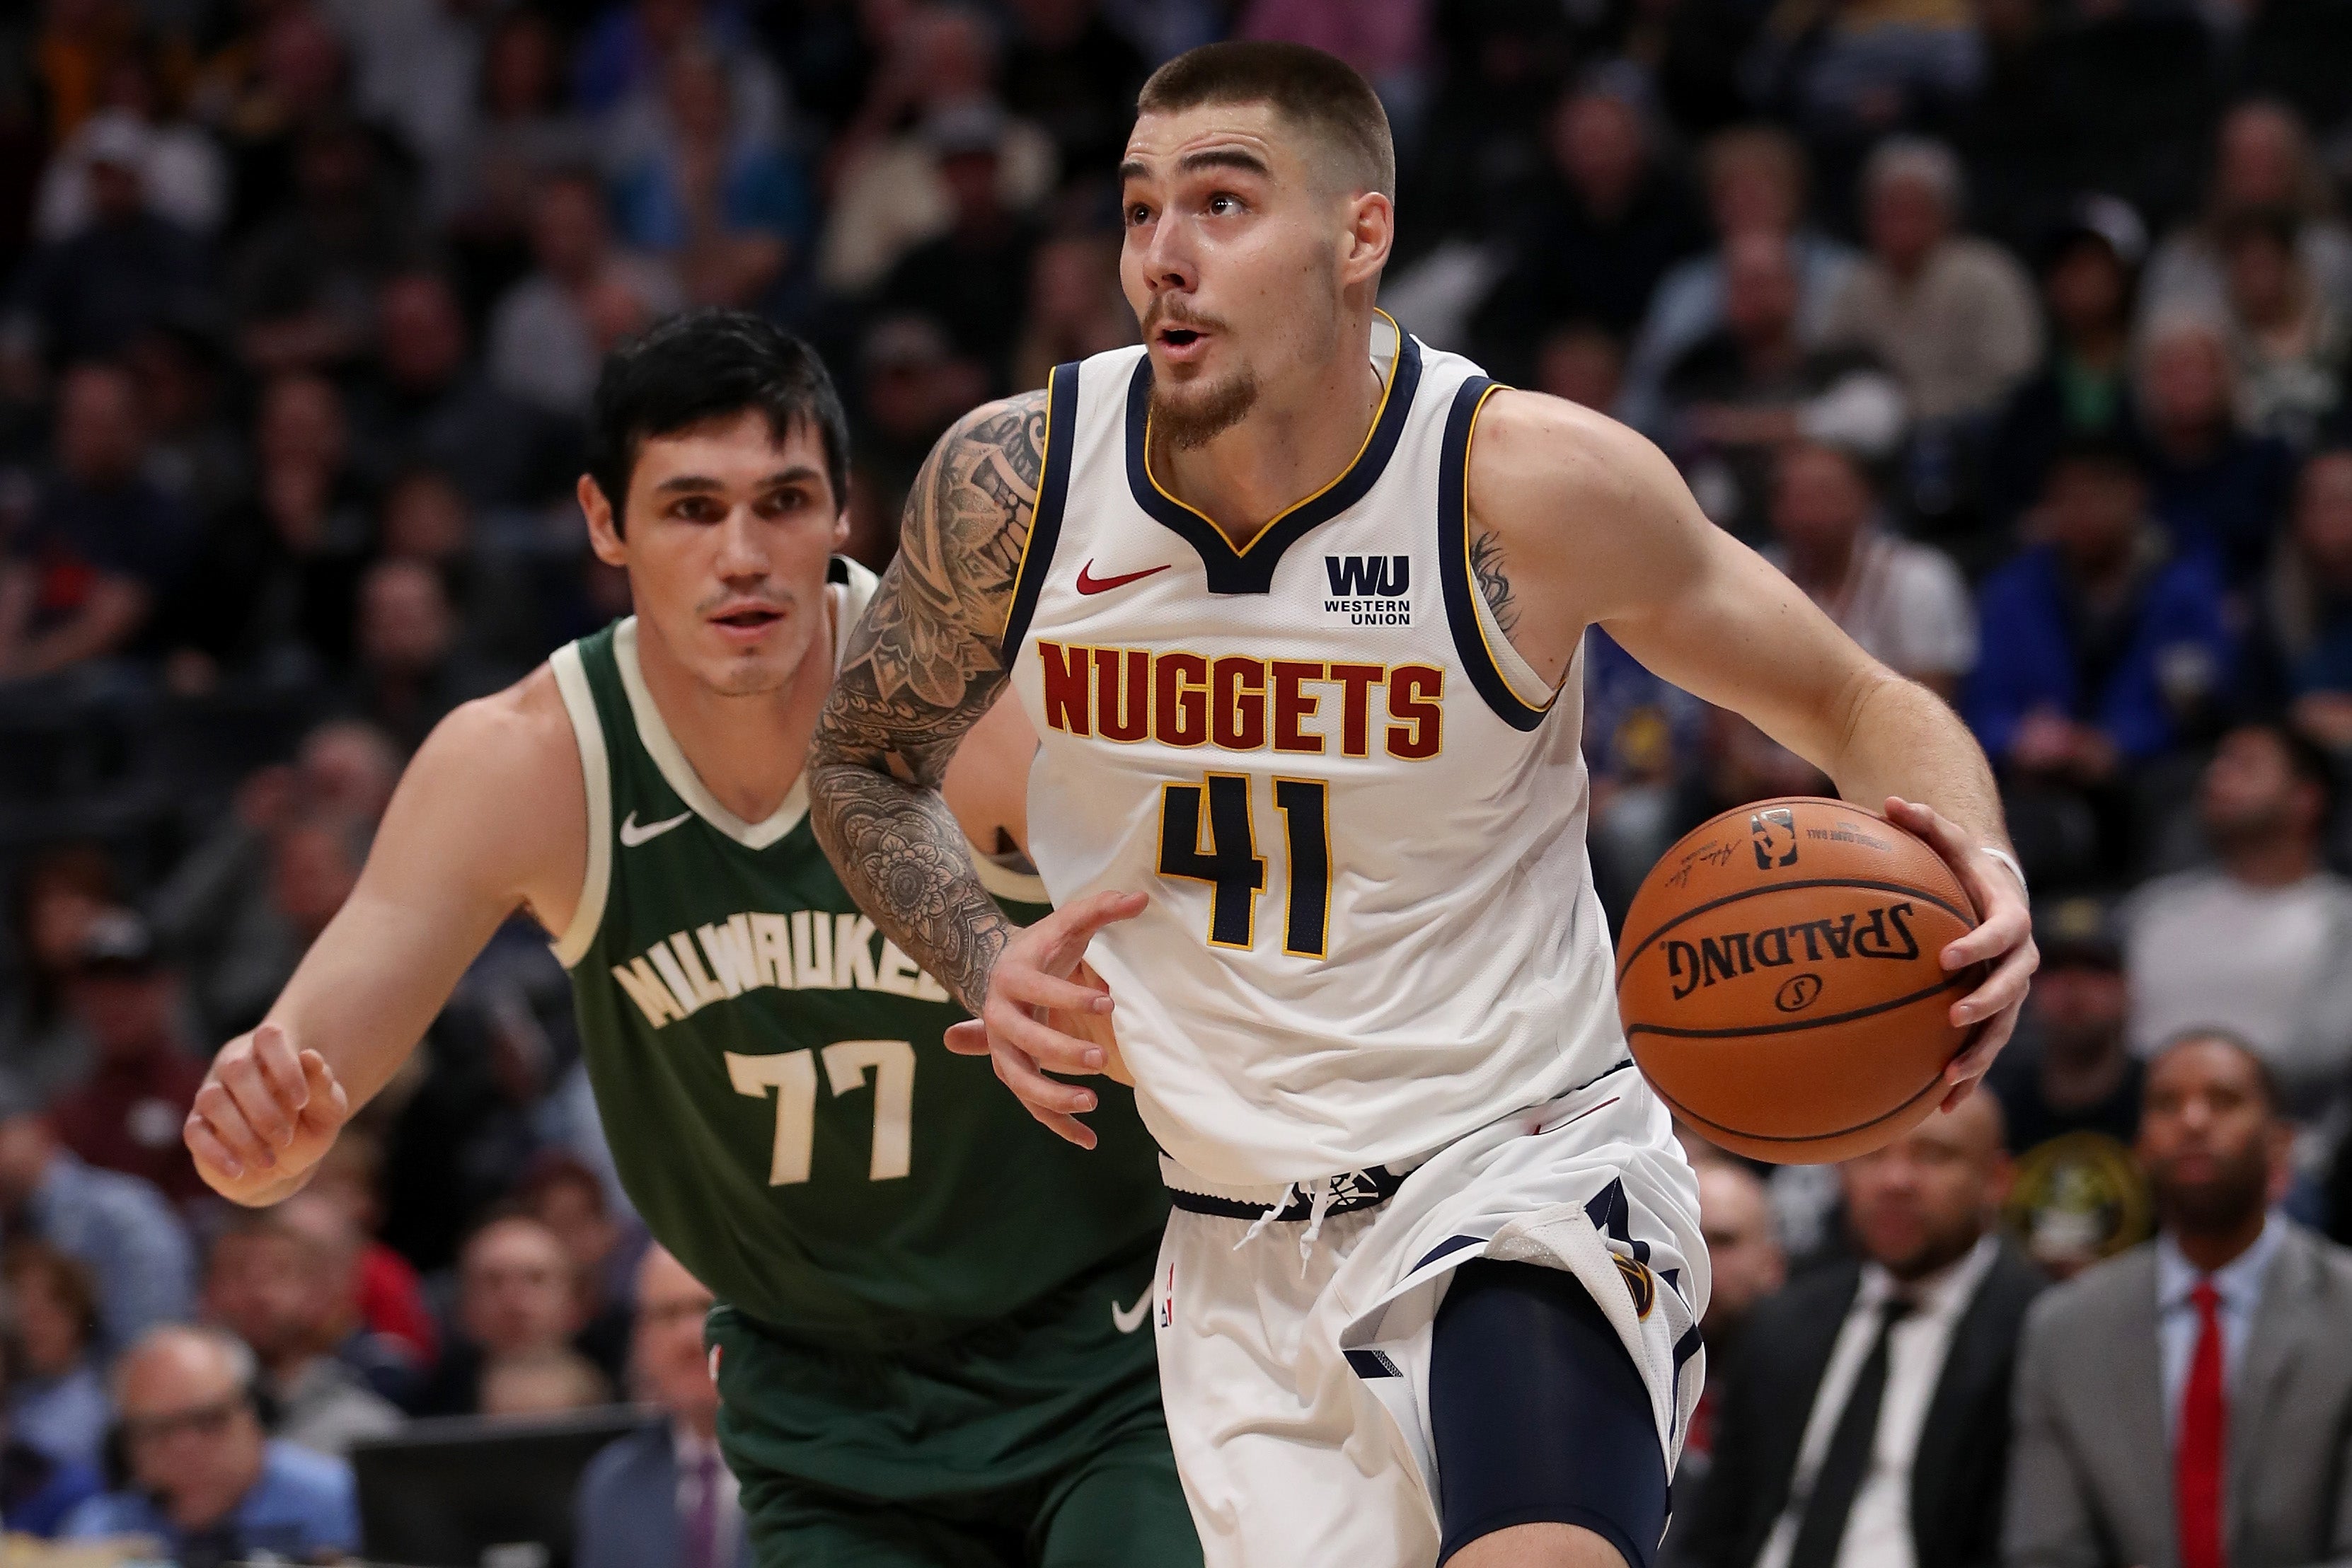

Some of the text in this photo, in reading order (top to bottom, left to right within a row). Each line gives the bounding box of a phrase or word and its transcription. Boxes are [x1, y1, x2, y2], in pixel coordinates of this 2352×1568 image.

[1325, 555, 1410, 596] WU
[1325, 601, 1410, 612] WESTERN
[1351, 613, 1410, 625] UNION
[1037, 640, 1444, 761] NUGGETS
[1156, 771, 1333, 961] 41
[1666, 902, 1920, 1001] SPALDING
[723, 1039, 917, 1187] 77
